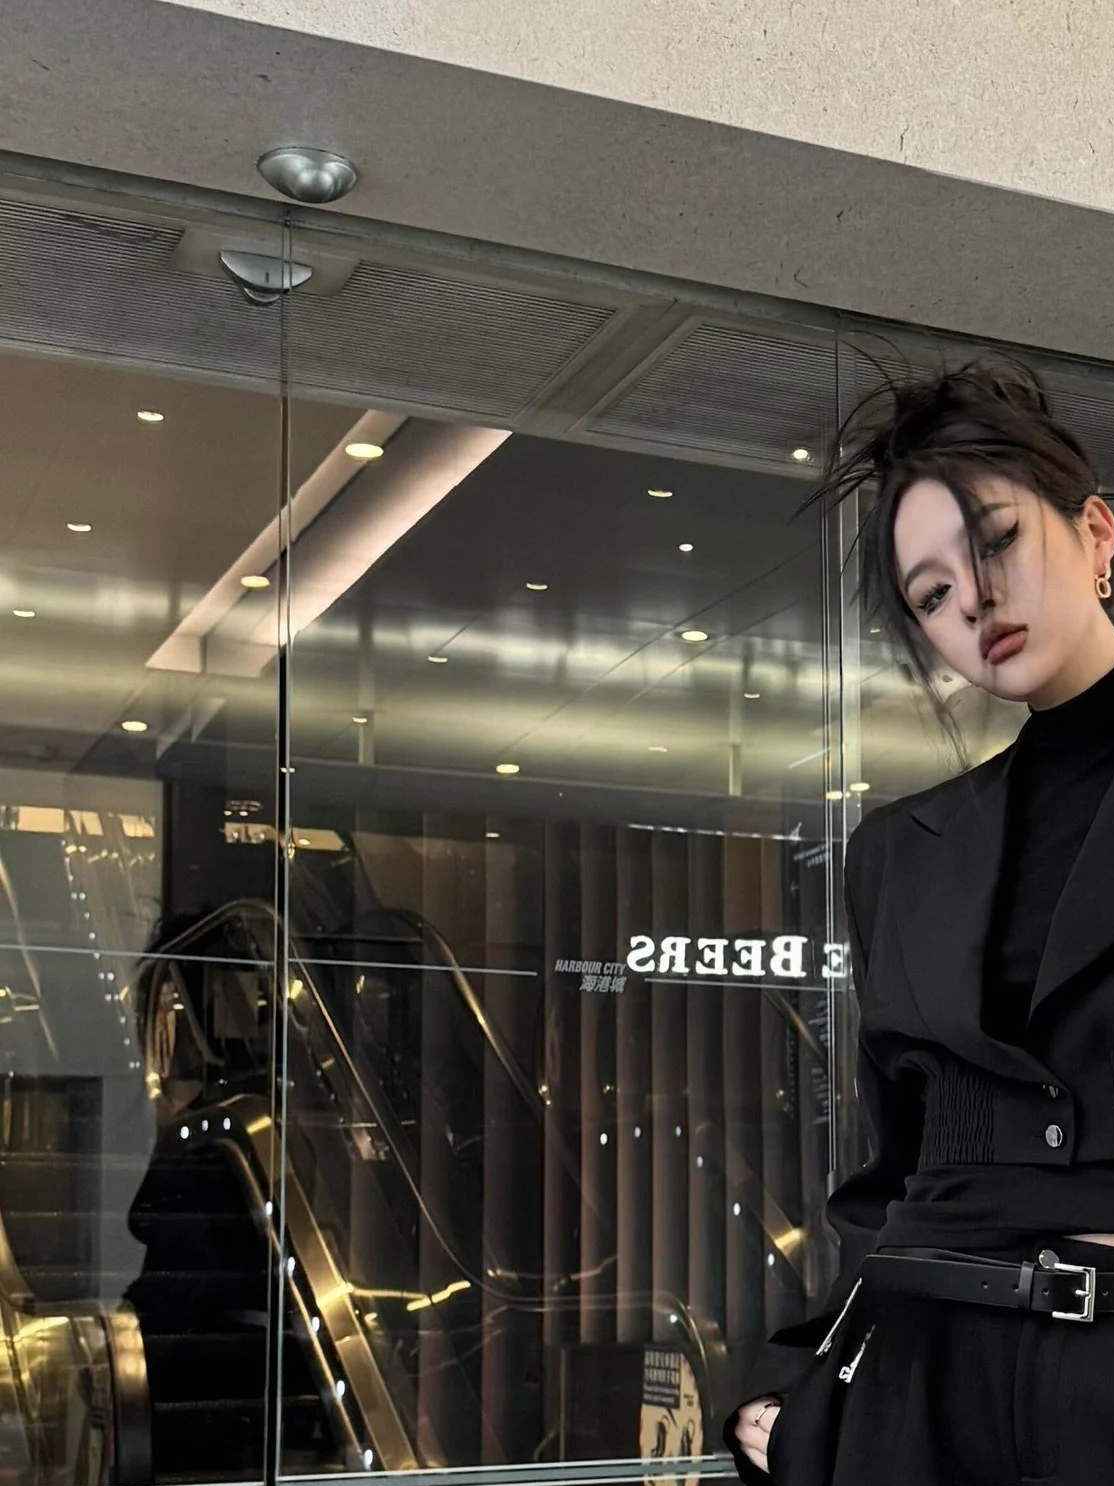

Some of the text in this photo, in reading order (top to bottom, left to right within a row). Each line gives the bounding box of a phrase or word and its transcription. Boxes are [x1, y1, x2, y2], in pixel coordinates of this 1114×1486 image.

[555, 959, 627, 975] HARBOUR CITY
[579, 974, 627, 993] 海港城
